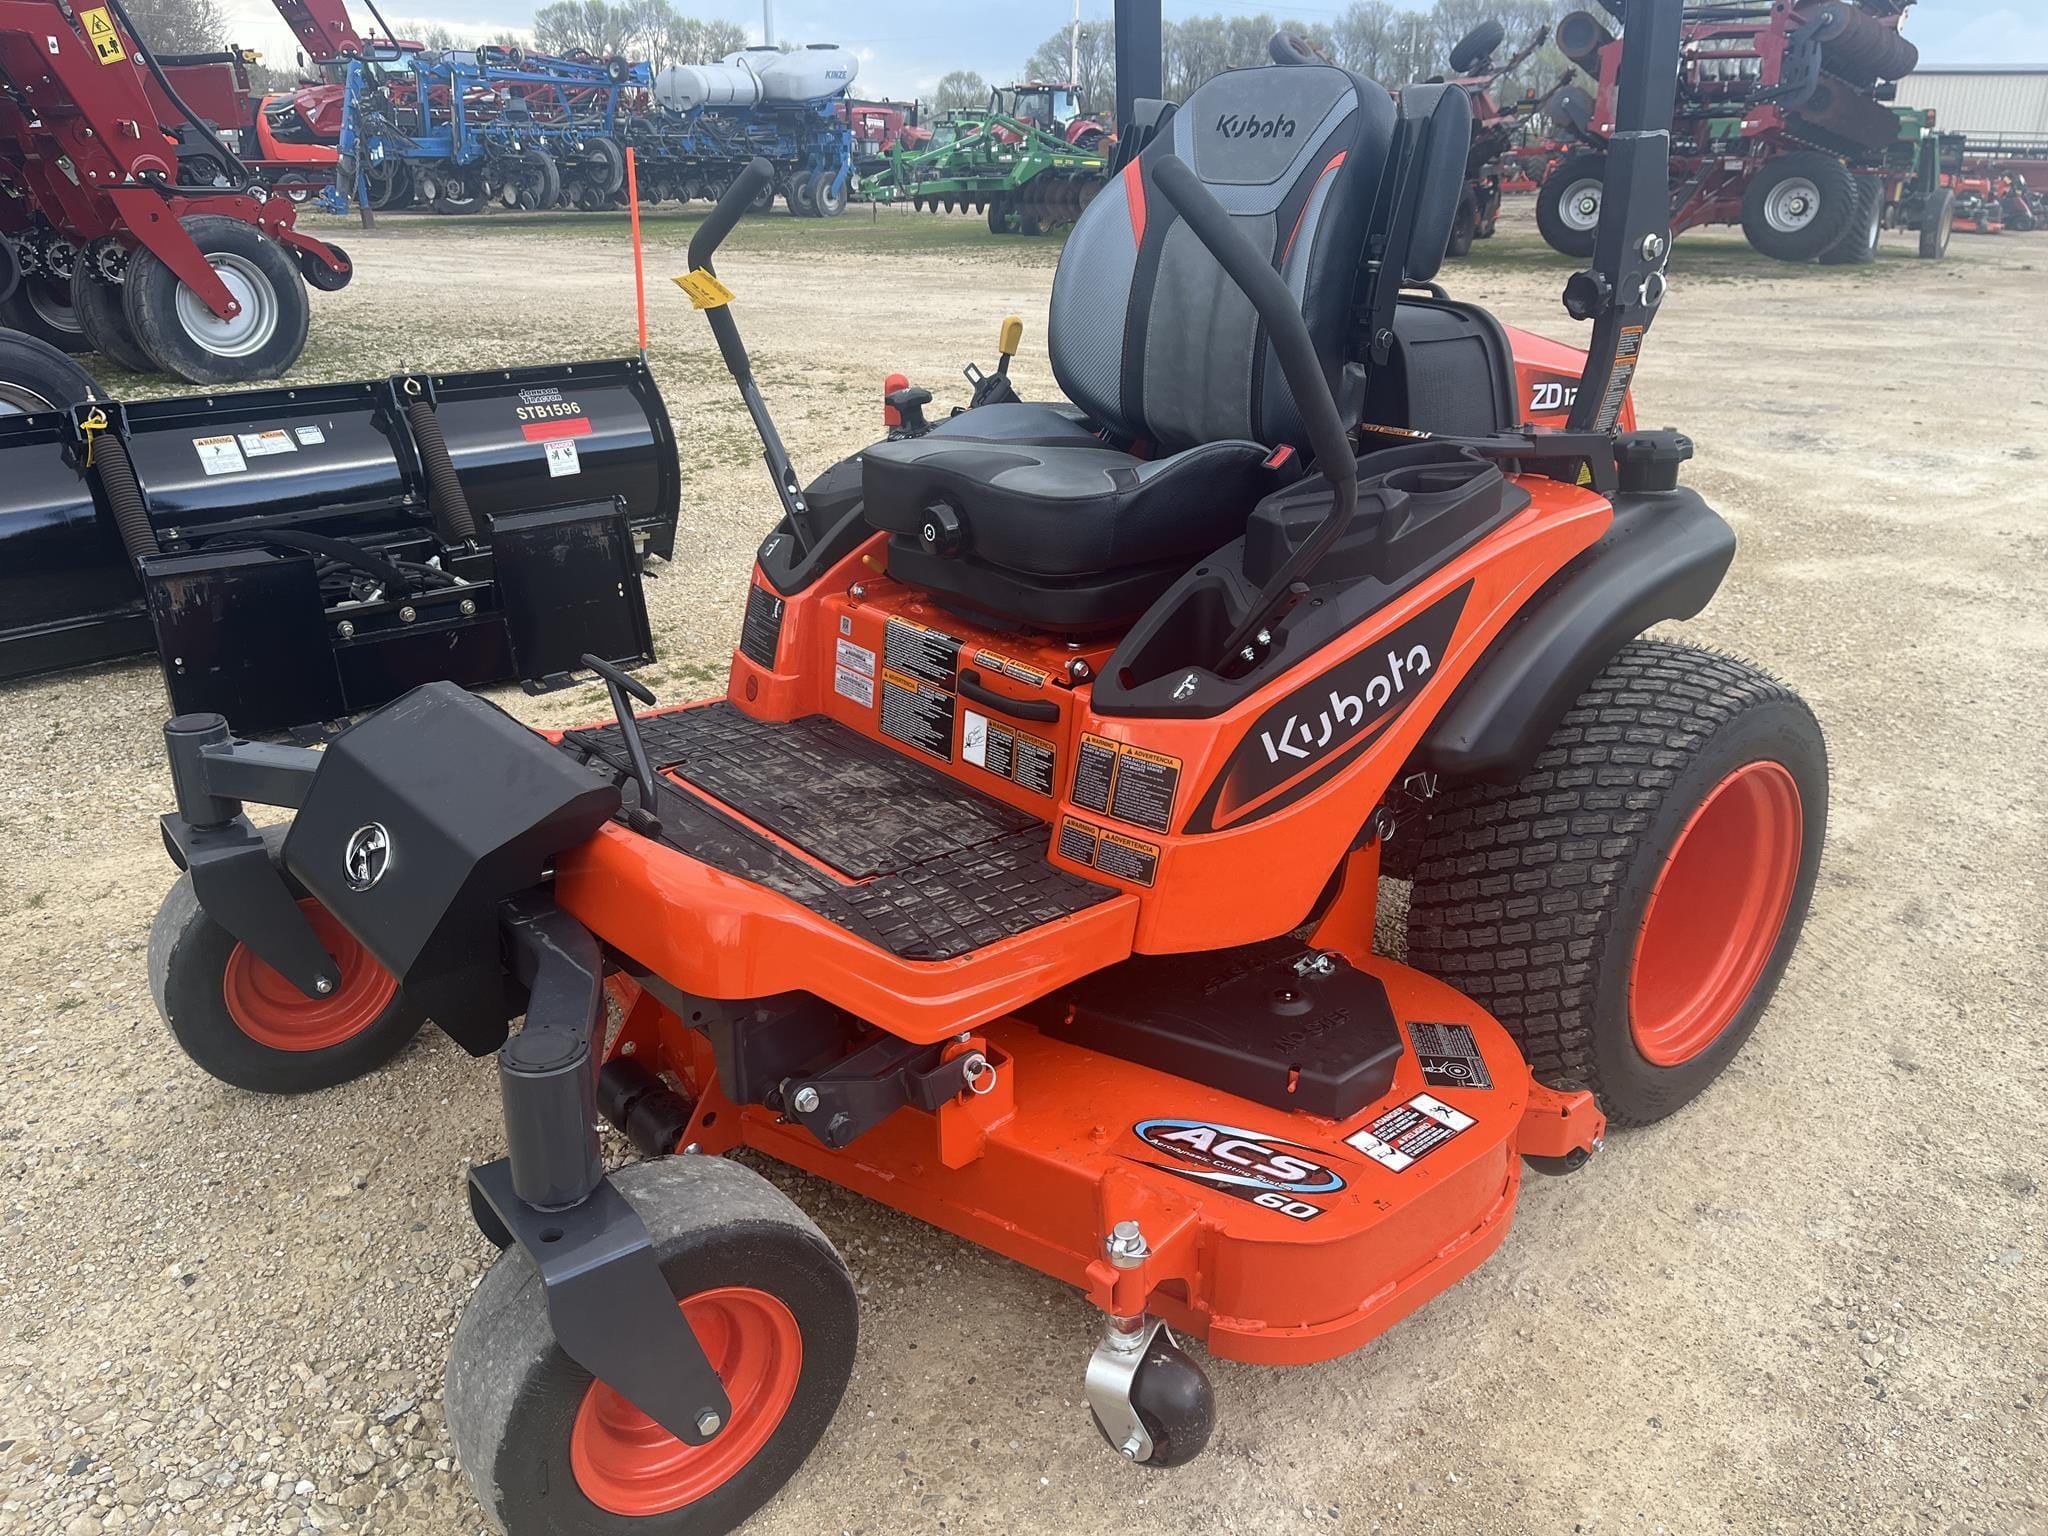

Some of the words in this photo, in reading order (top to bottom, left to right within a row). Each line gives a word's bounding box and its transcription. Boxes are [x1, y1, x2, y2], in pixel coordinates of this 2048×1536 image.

[824, 70, 847, 79] KINZE
[1215, 113, 1296, 138] Kubota
[516, 402, 581, 420] STB1596
[203, 436, 232, 446] WARNING
[1260, 644, 1432, 764] Kubota
[1091, 737, 1114, 749] WARNING
[1134, 750, 1174, 766] ADVERTENCIA
[1069, 819, 1096, 834] WARNING
[1111, 834, 1154, 853] ADVERTENCIA
[1377, 1107, 1406, 1127] DANGER
[1403, 1122, 1432, 1142] PELIGRO
[1158, 1128, 1321, 1181] ACS
[1150, 1138, 1211, 1163] Aerodynamic
[1212, 1159, 1252, 1177] Cutting
[1254, 1174, 1294, 1191] System
[1253, 1192, 1319, 1219] 60
